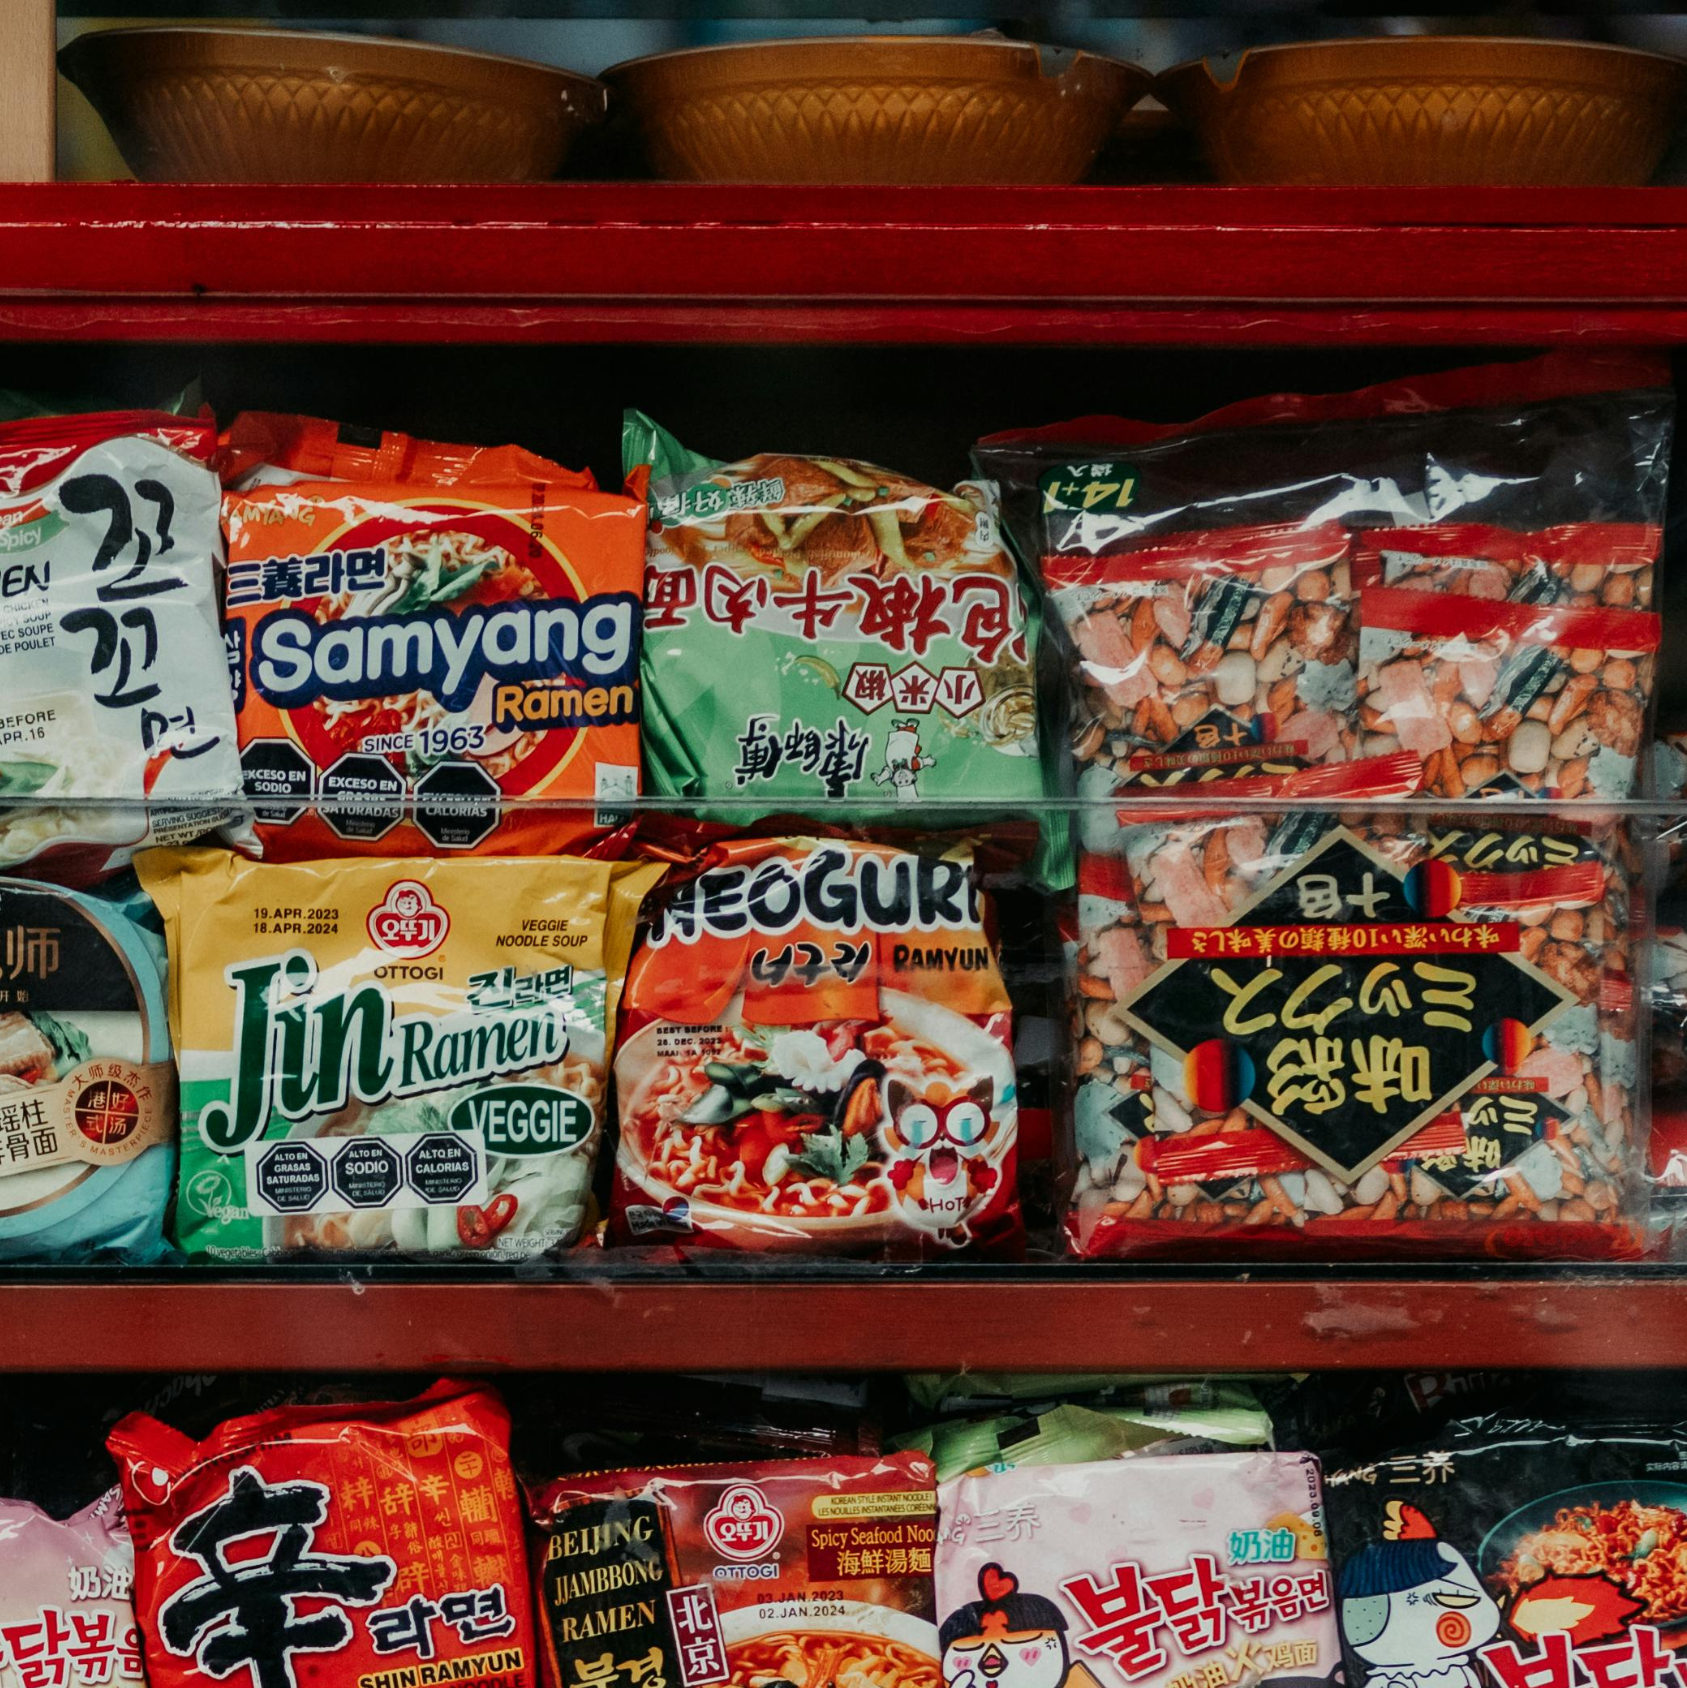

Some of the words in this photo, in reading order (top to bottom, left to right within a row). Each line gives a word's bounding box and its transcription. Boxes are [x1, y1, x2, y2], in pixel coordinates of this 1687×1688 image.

[227, 547, 386, 608] 三養라면
[15, 637, 56, 652] POULET
[18, 623, 54, 638] SOUPE
[258, 601, 632, 695] Samyang
[496, 686, 634, 724] Ramen
[364, 733, 414, 753] SINCE
[419, 726, 485, 755] 1963
[734, 715, 872, 798] 康師傅
[330, 777, 377, 789] EXCESO
[380, 780, 397, 791] EN
[1296, 873, 1391, 919] 十色
[253, 907, 339, 920] 19.APR.2023
[253, 922, 339, 934] 18.APR.2024
[521, 919, 568, 931] VEGGIE
[381, 920, 436, 942] 오뚜기
[496, 935, 549, 948] NOODLE
[552, 934, 588, 947] SOUP
[1192, 925, 1502, 953] 味わい深い10種類の美味しさ
[751, 941, 871, 984] 너구리
[893, 944, 989, 972] RAMYUN
[374, 966, 444, 980] OTTOGI
[1210, 961, 1478, 1035] ミックス
[204, 954, 394, 1147] Jin
[398, 1012, 560, 1089] Ramen
[1268, 1034, 1433, 1116] 味彩
[468, 1099, 577, 1142] VEGGIE
[345, 1162, 388, 1175] SODIO
[416, 1162, 469, 1173] CALORIAS
[548, 1516, 654, 1561] BEIJING
[719, 1523, 770, 1542] 오뚜기
[812, 1529, 848, 1549] Spicy
[851, 1526, 902, 1545] Seafood
[1228, 1529, 1295, 1565] 奶油
[837, 1547, 932, 1576] 海鮮湯麵
[367, 1583, 516, 1659] 라면
[562, 1600, 656, 1643] RAMEN
[759, 1605, 845, 1619] 02.JAN.2024
[1061, 1556, 1329, 1681] 불닭볶음면
[422, 1650, 524, 1687] RAMYUN
